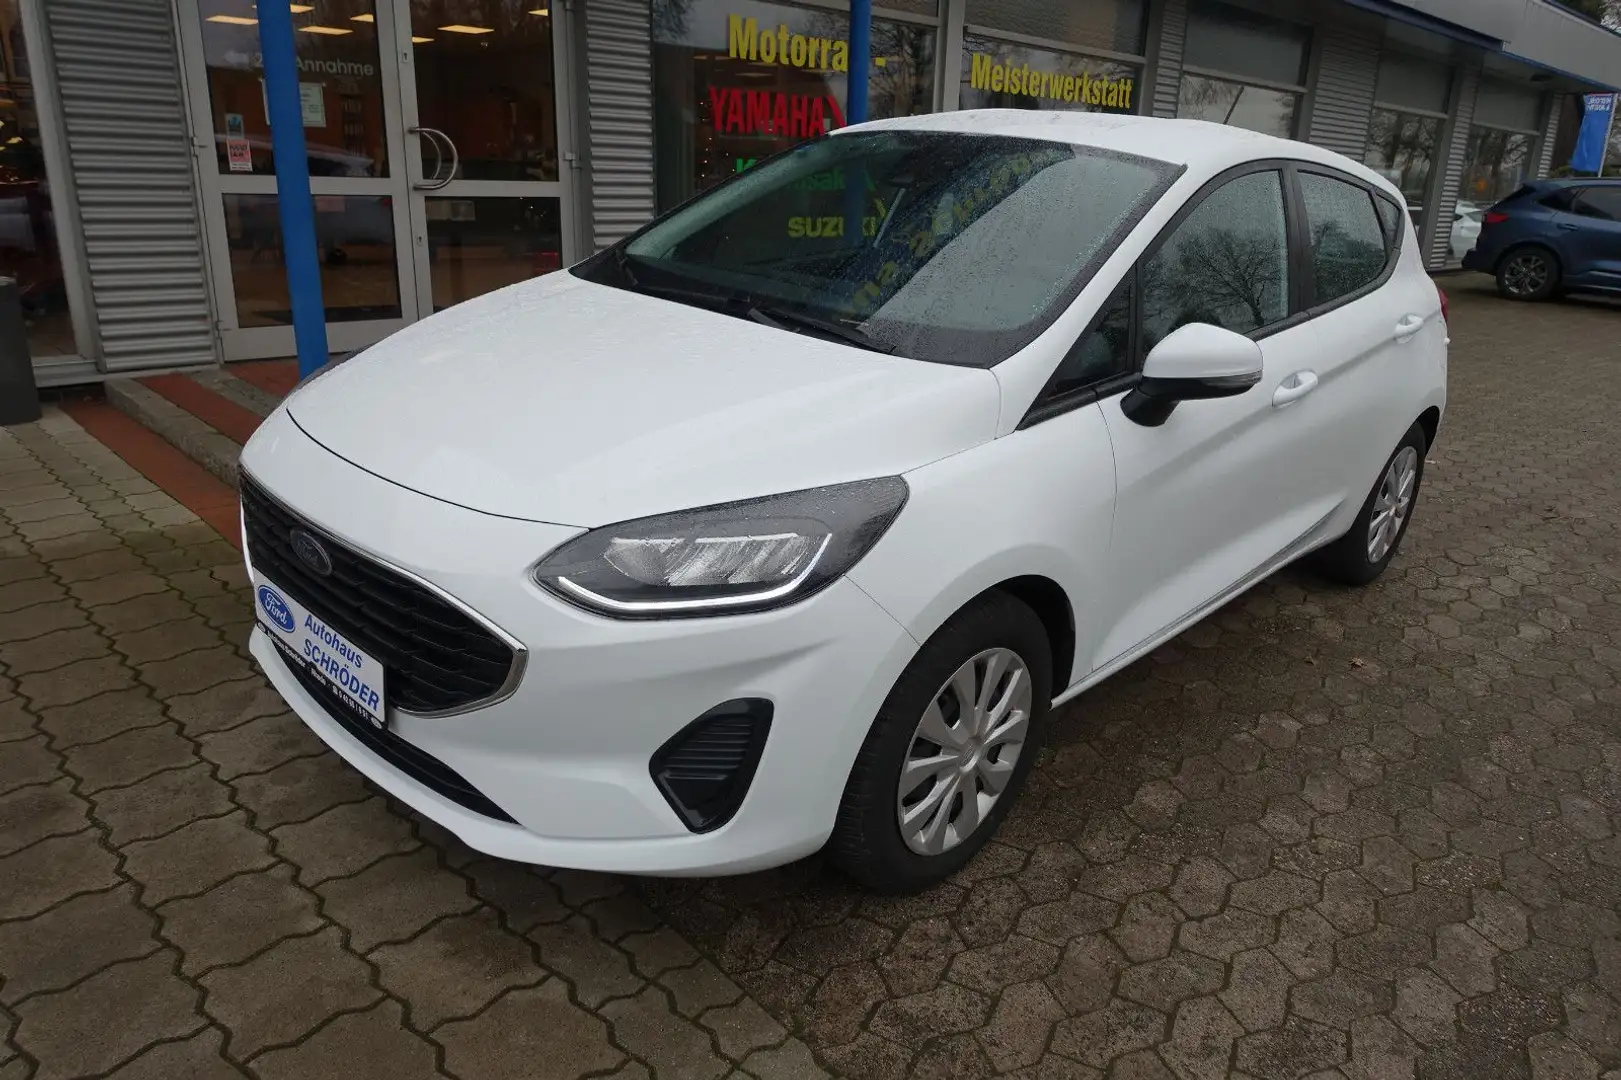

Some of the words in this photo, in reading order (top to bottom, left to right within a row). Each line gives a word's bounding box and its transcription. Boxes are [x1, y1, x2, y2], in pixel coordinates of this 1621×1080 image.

[728, 14, 886, 73] Motorra-
[970, 52, 1133, 109] Meisterwerkstatt
[709, 86, 825, 138] YAMAHA
[265, 592, 287, 625] Ford
[304, 614, 363, 668] Autohaus
[304, 639, 380, 712] SCHRÖDER
